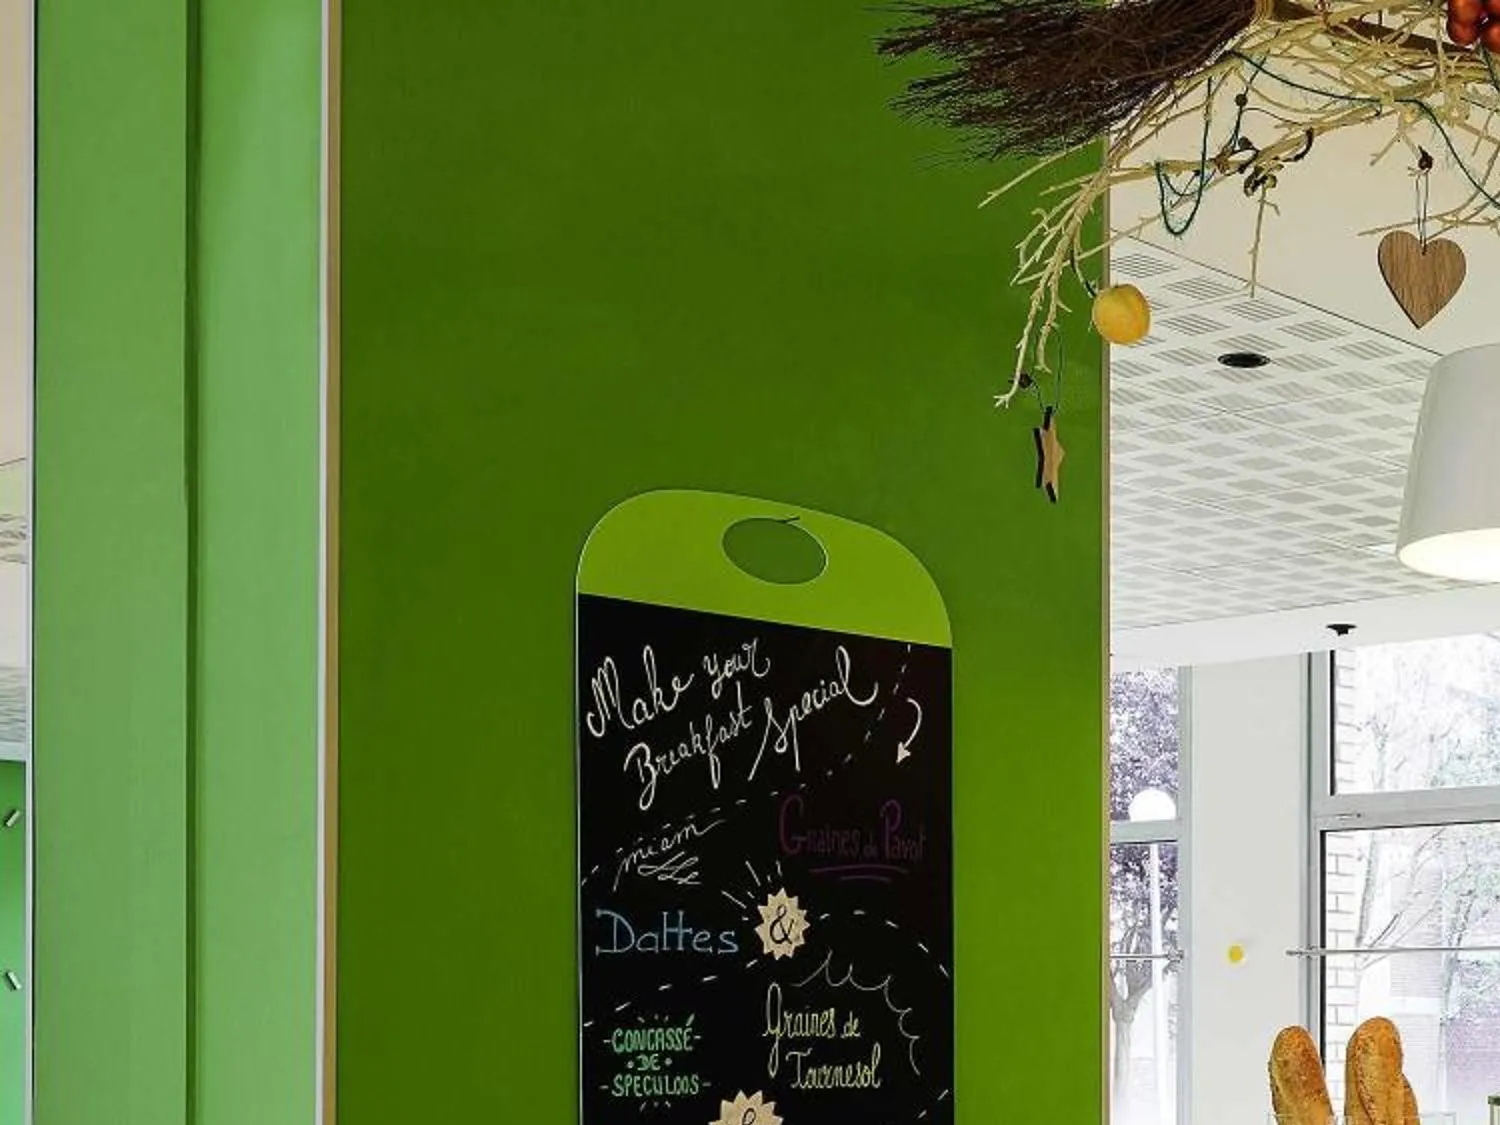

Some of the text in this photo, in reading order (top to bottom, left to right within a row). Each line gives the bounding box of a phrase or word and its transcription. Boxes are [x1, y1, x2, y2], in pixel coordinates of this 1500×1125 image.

[586, 638, 770, 737] Make your
[623, 681, 753, 811] Breakfast
[595, 908, 740, 956] Dattes
[768, 903, 798, 945] &
[611, 1014, 695, 1054] CONCASSÉ
[840, 1010, 862, 1040] de
[636, 1053, 661, 1072] DE
[785, 1043, 882, 1090] Tournesol
[611, 1073, 700, 1098] SPECULOOS
